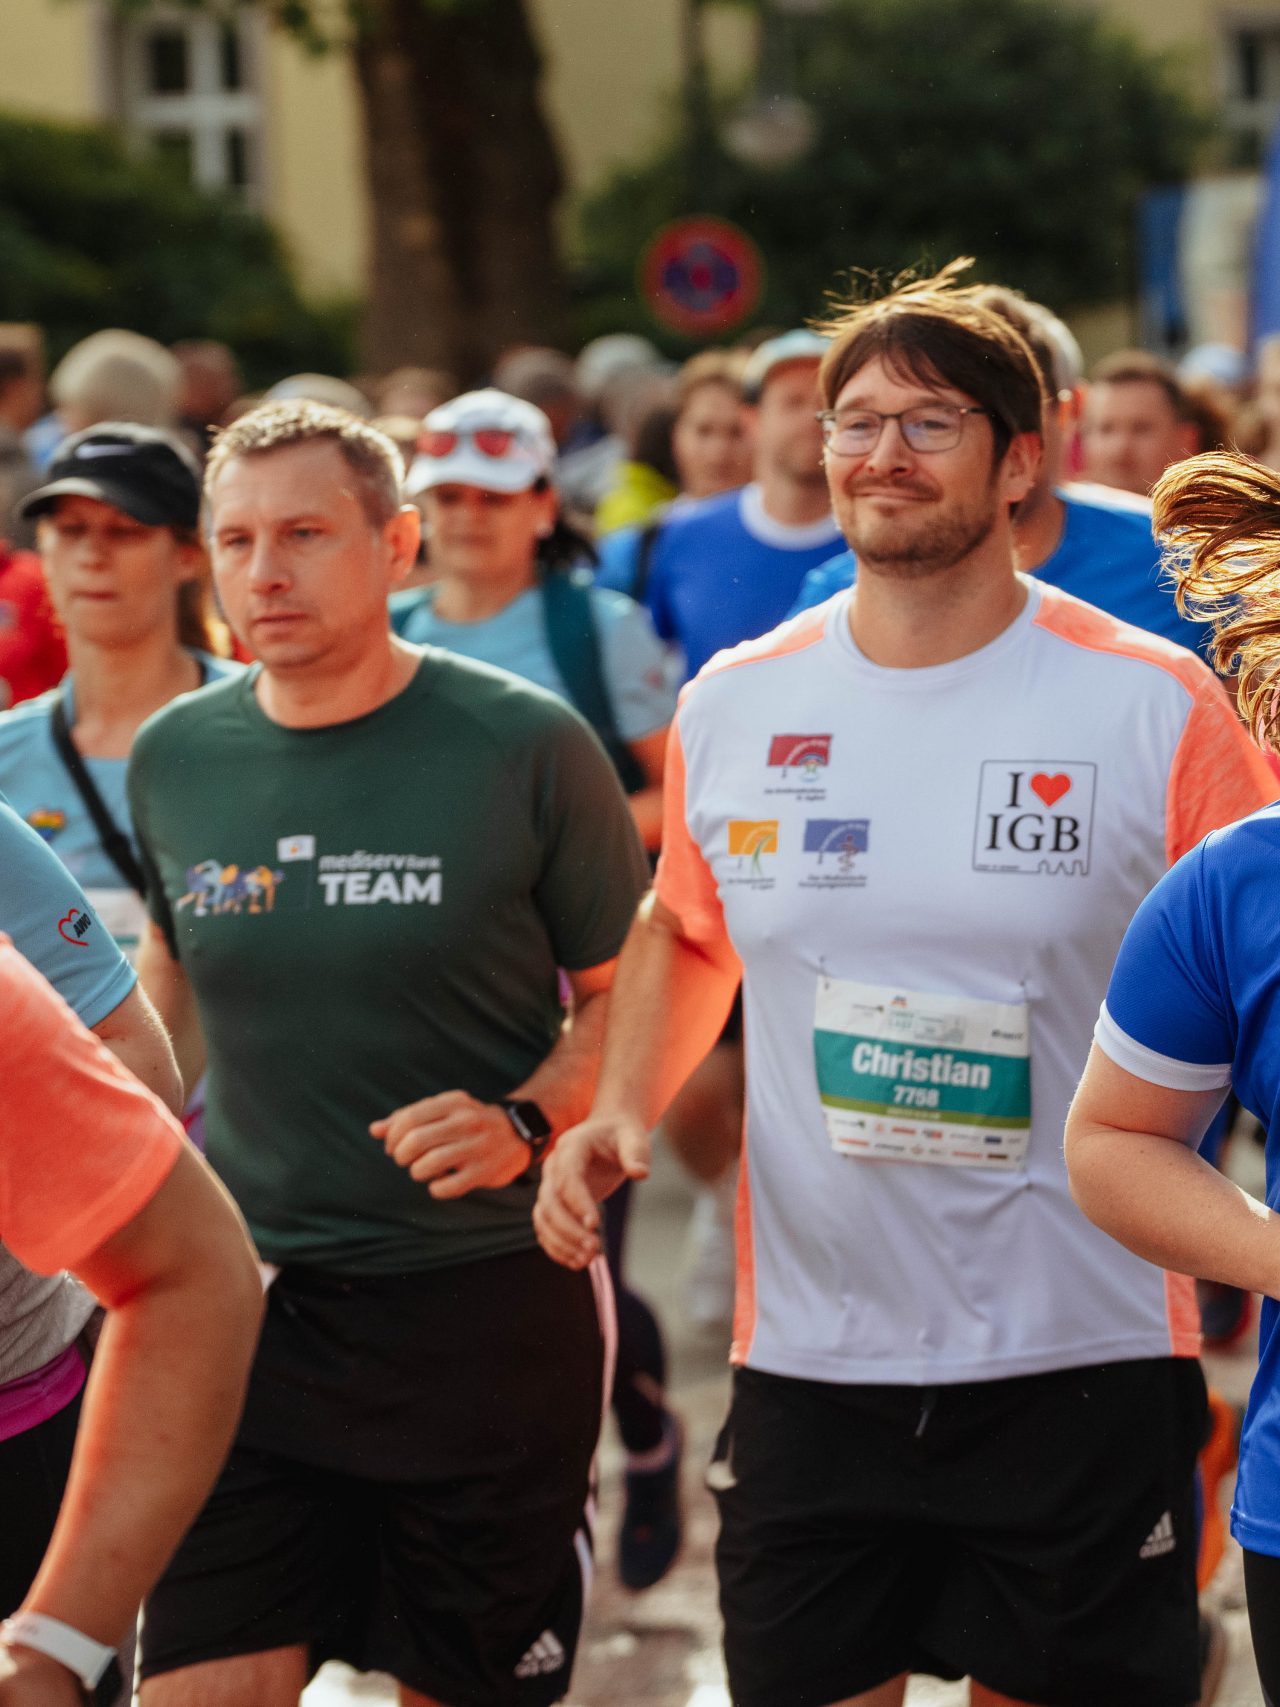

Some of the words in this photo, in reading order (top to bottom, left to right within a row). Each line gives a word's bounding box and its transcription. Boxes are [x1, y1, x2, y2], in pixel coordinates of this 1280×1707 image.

[1005, 771, 1024, 808] I
[985, 813, 1080, 853] IGB
[318, 872, 442, 905] TEAM
[852, 1041, 992, 1090] Christian
[893, 1084, 940, 1107] 7758
